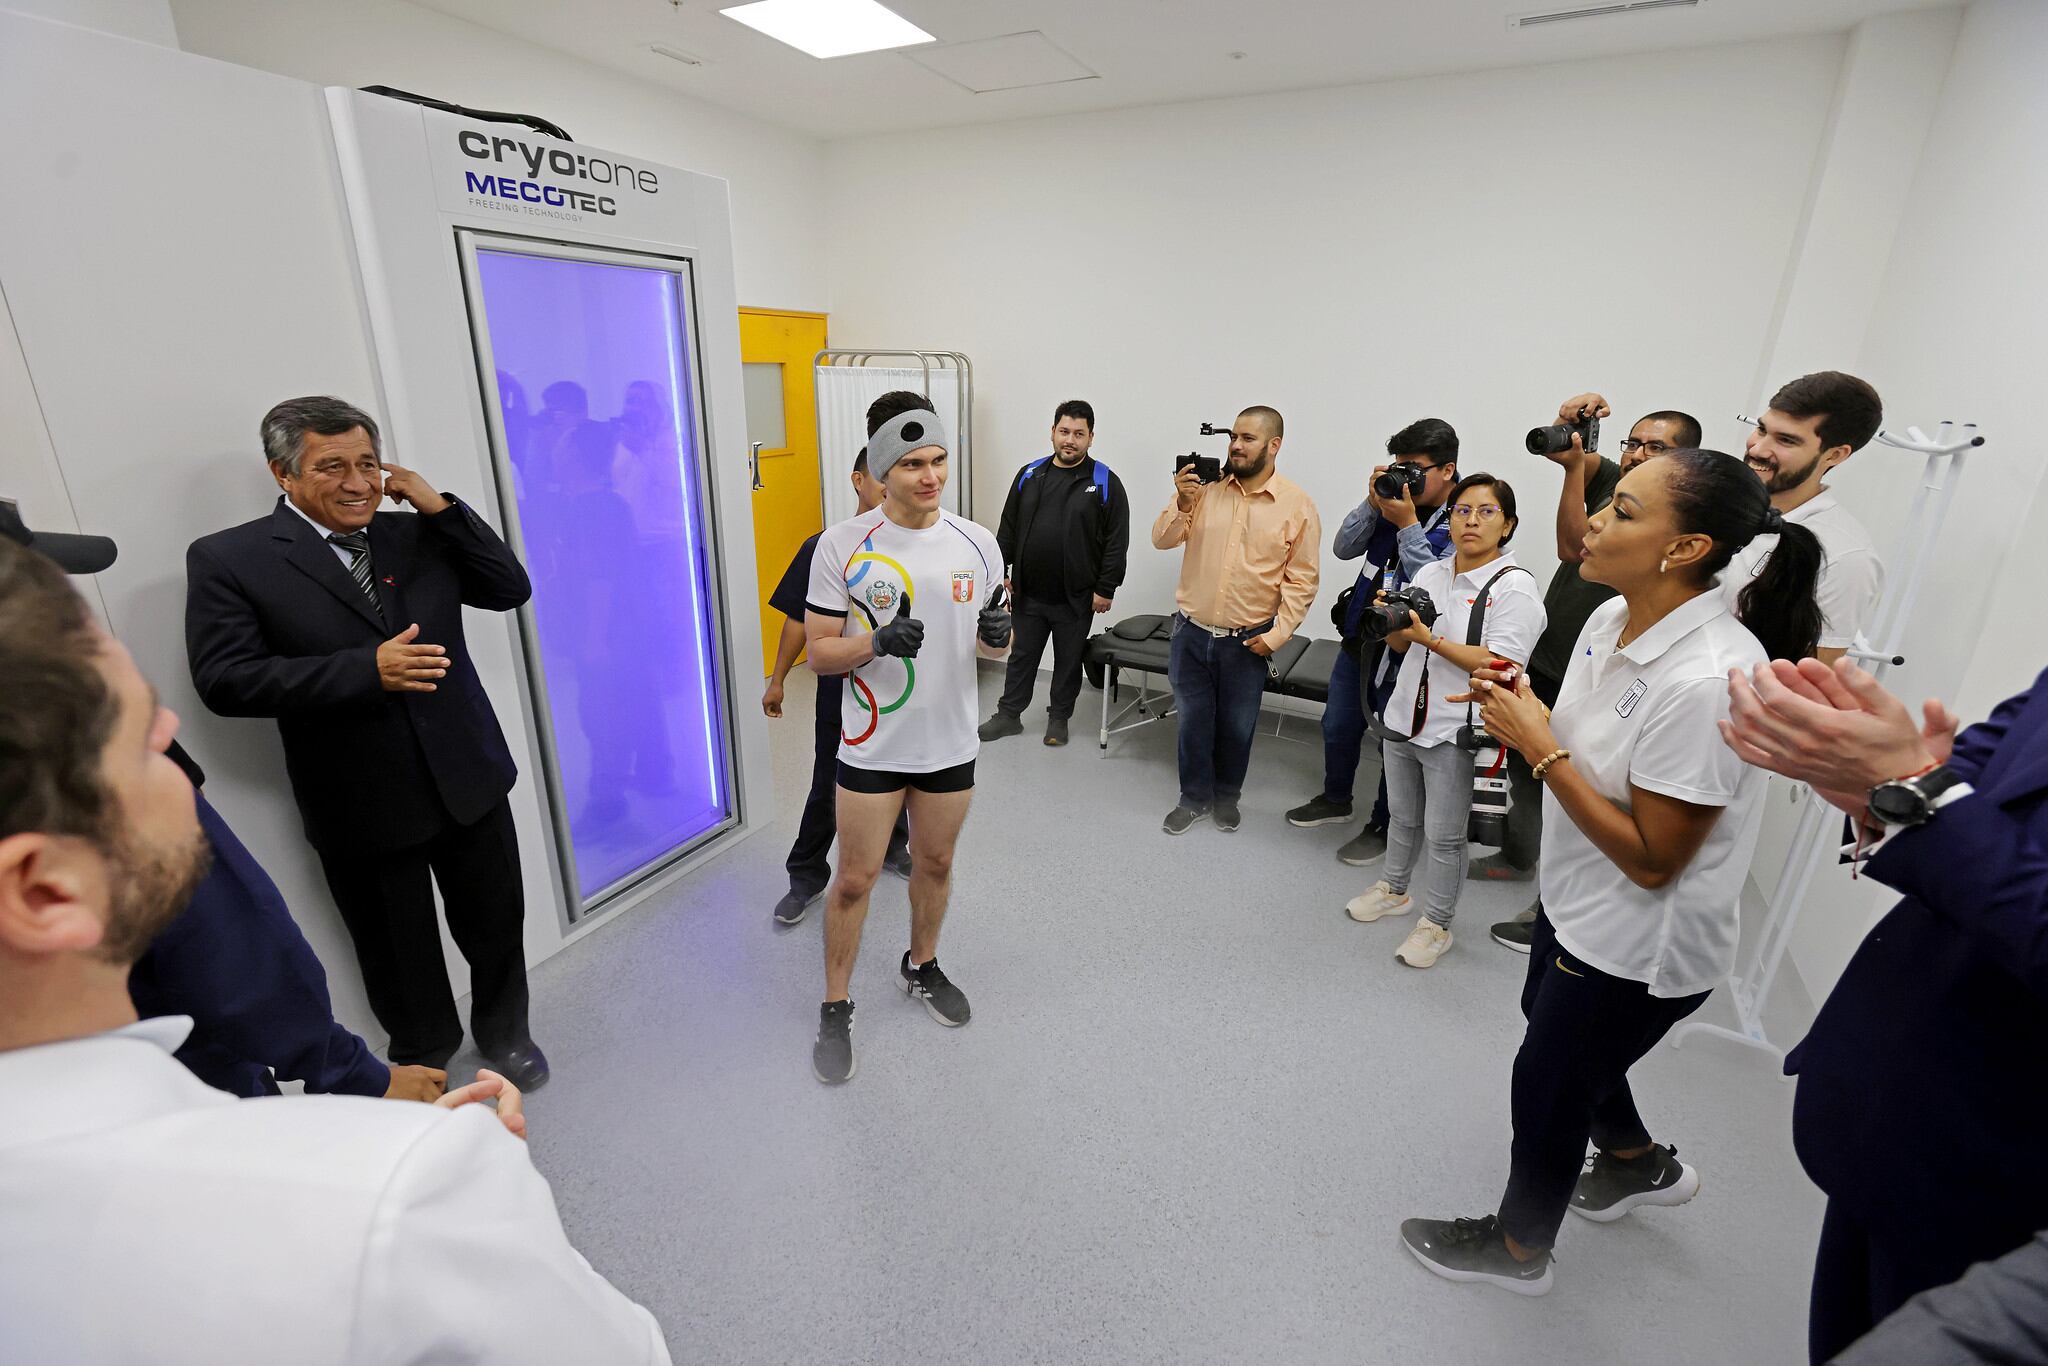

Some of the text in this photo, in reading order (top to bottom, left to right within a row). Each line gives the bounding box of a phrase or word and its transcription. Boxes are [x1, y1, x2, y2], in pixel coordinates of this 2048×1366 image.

[458, 130, 658, 194] cryo:one
[465, 171, 617, 216] MECOTEC
[468, 197, 583, 222] FREEZING TECHNOLOGY
[1417, 685, 1425, 709] Canon
